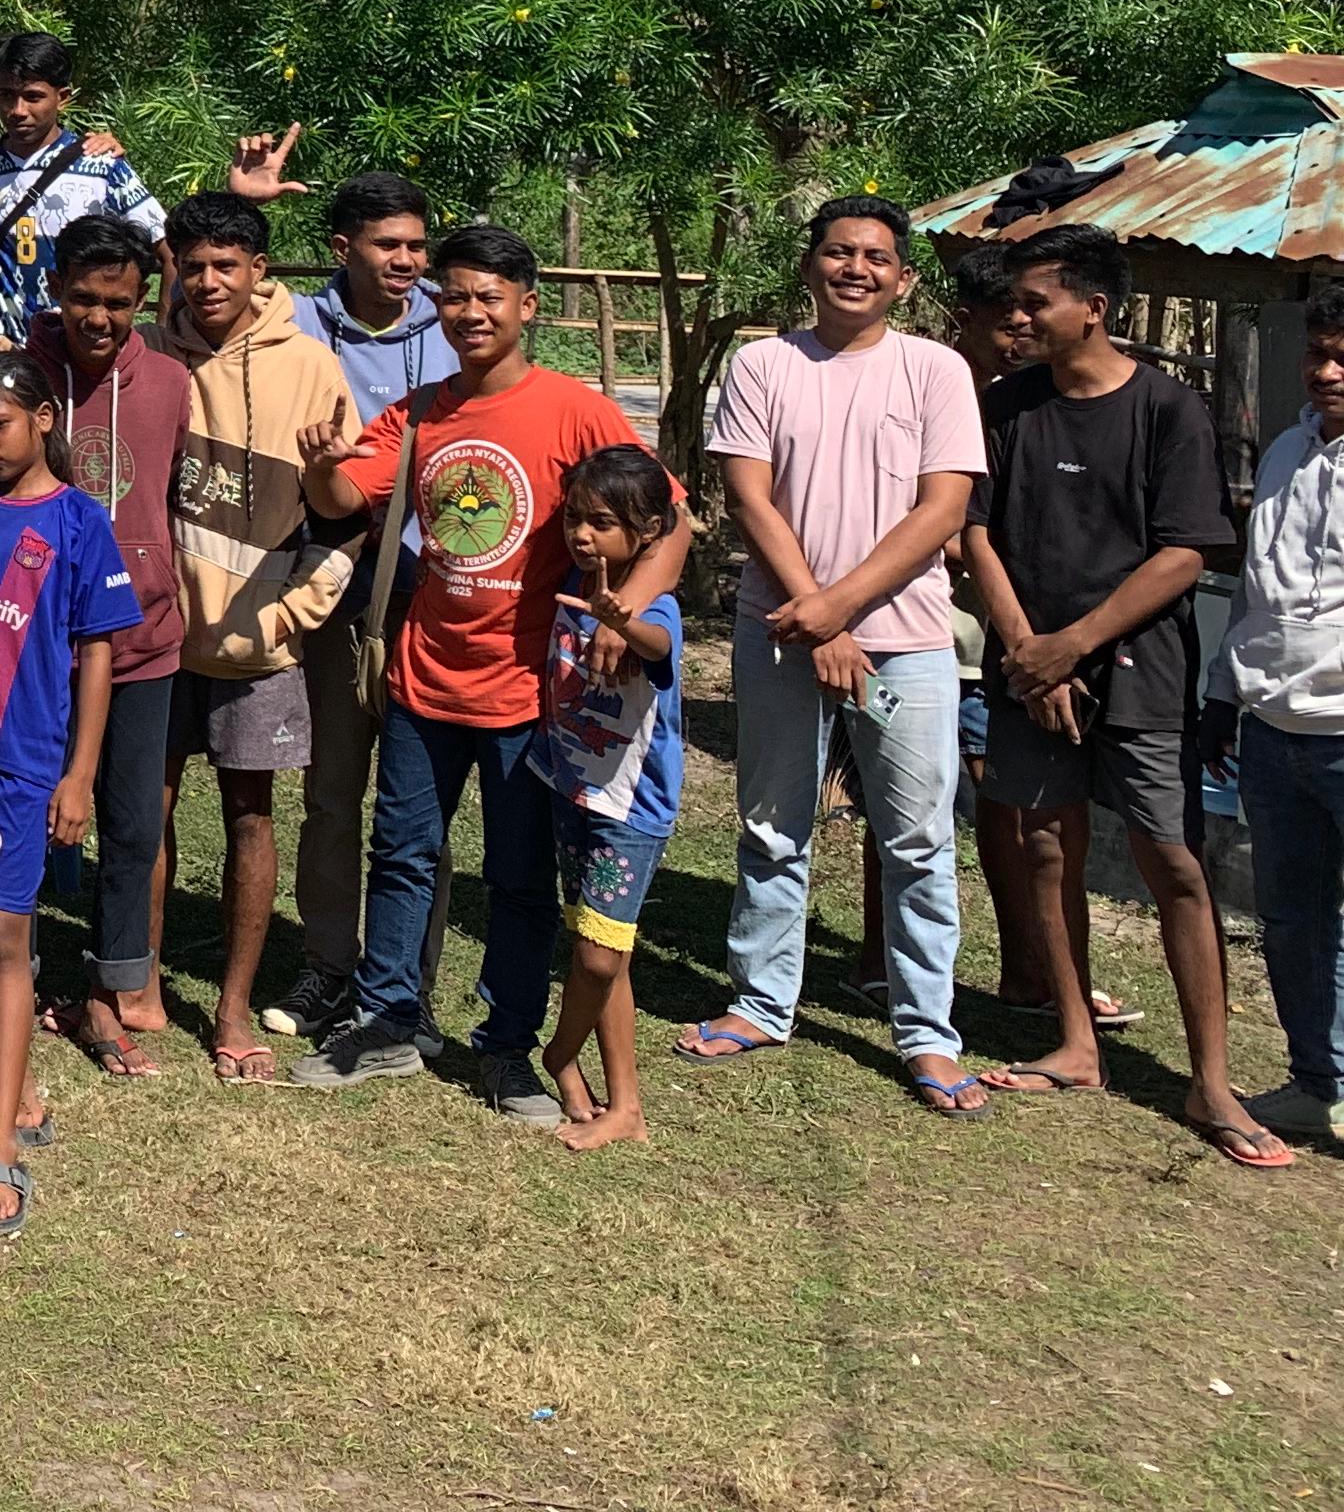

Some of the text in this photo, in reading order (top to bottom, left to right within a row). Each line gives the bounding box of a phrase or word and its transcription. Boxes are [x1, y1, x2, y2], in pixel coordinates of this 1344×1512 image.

[16, 216, 37, 265] 8
[442, 448, 474, 464] KERJA
[474, 448, 508, 472] NYATA
[504, 465, 528, 514] REGULER
[462, 524, 523, 567] TERINTEGRASI
